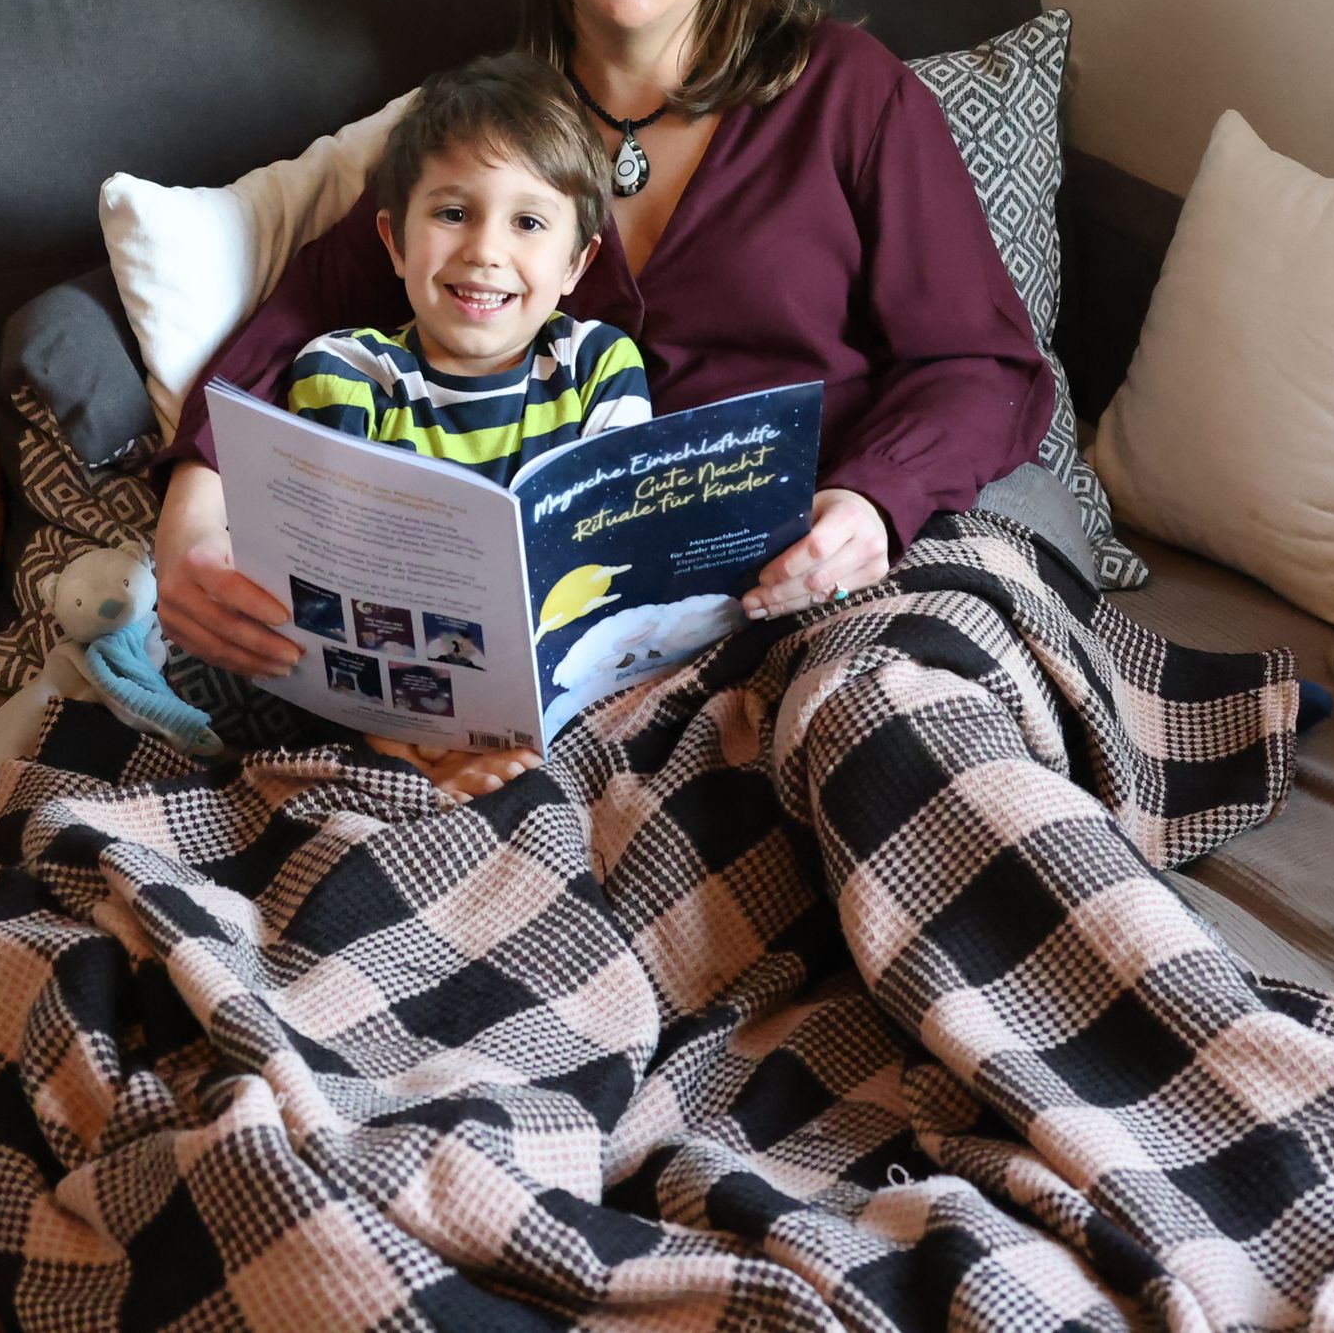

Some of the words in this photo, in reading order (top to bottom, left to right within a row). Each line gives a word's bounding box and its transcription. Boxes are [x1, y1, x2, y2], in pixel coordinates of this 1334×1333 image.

[534, 468, 627, 523] Magische
[630, 424, 781, 475] Einschlafhilfe
[636, 467, 693, 500] Gute
[698, 446, 775, 484] Nacht
[571, 499, 656, 542] Rituale
[658, 492, 695, 513] für
[703, 472, 776, 502] Kinder
[689, 528, 750, 547] Mitmachbuch
[670, 552, 683, 560] für
[685, 546, 708, 556] mehr
[728, 541, 765, 555] Bindung
[673, 566, 691, 575] und
